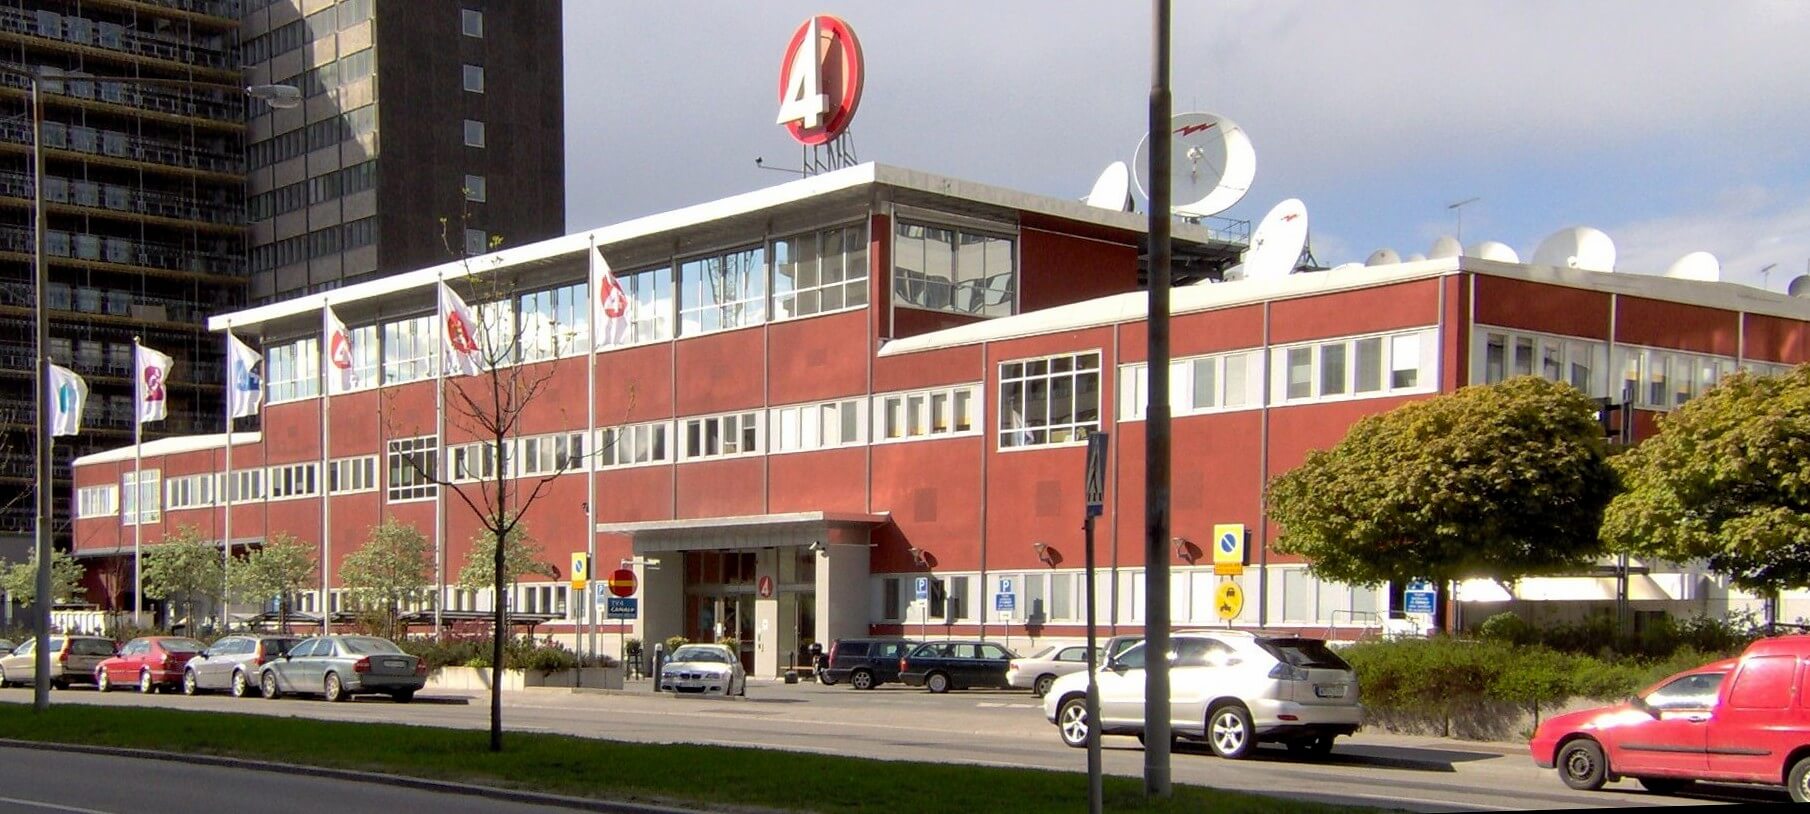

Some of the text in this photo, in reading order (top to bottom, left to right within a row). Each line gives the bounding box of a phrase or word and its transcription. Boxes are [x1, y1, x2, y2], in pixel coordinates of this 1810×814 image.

[776, 15, 829, 129] 4
[604, 286, 623, 314] 4
[761, 577, 770, 597] 4
[1002, 580, 1010, 592] P
